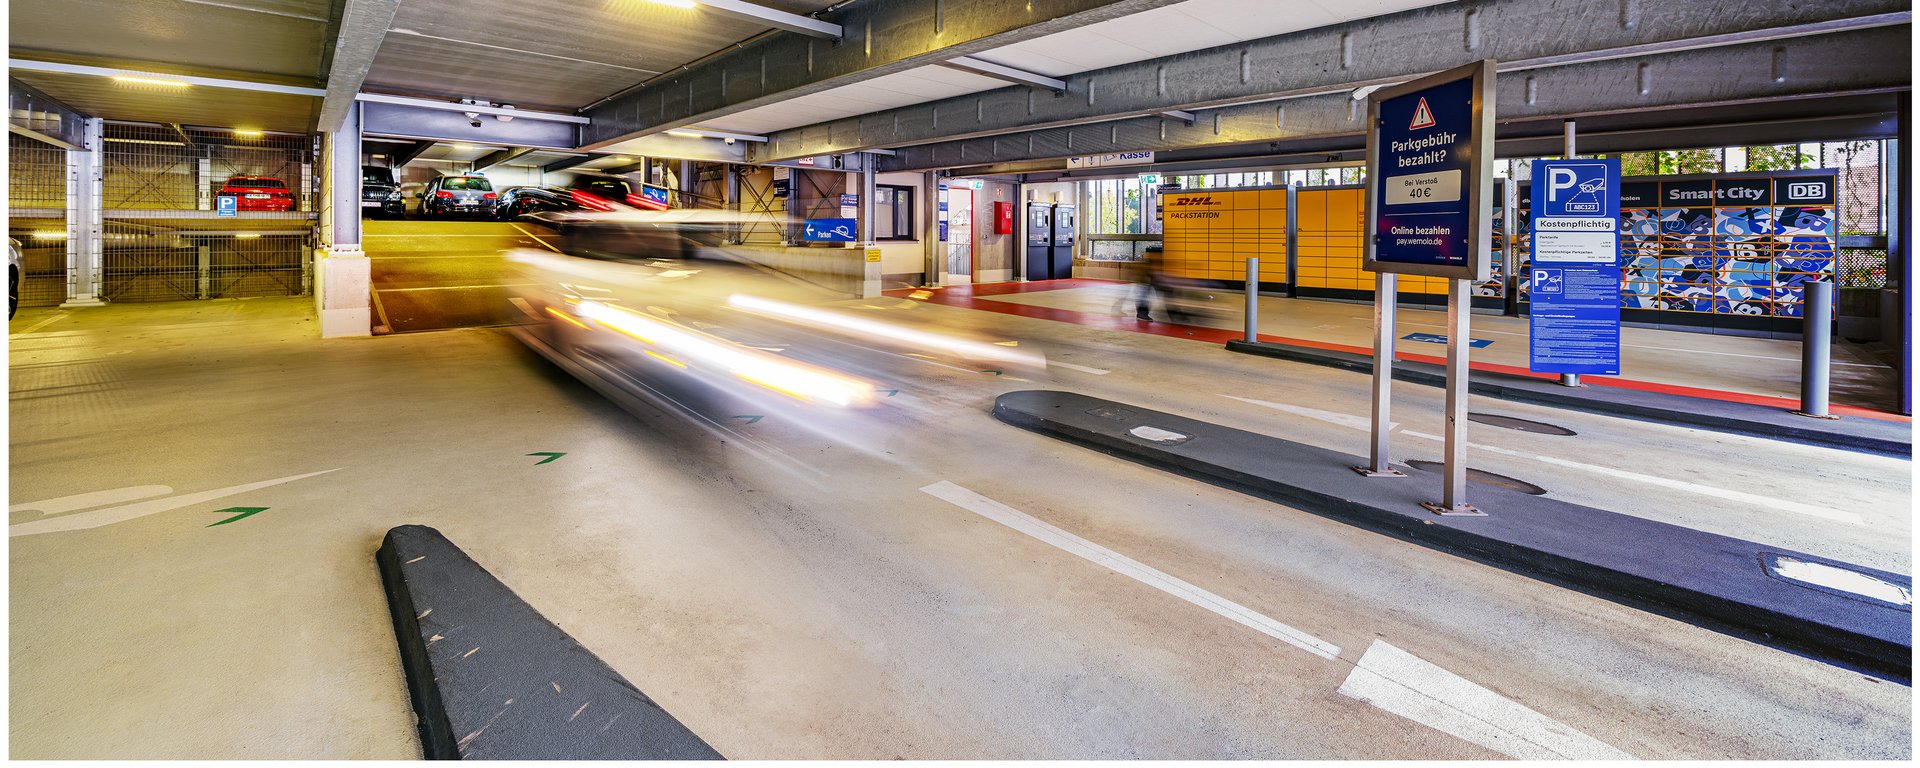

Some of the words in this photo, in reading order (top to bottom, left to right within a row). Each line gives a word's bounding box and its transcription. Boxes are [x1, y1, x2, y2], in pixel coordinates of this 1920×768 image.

[1391, 132, 1457, 153] Parkgebühr
[1398, 149, 1447, 168] bezahlt?
[1404, 179, 1414, 187] Bei
[1415, 177, 1438, 186] Verstoß
[1548, 168, 1577, 202] P
[1669, 187, 1725, 200] Smart
[1727, 186, 1765, 201] City
[1792, 185, 1822, 198] DB
[221, 197, 233, 209] P
[1176, 196, 1214, 206] DHL
[1170, 211, 1220, 219] PACKSTATION
[1540, 219, 1611, 230] Kostenpflichtig
[817, 231, 832, 239] Parken
[1391, 227, 1414, 236] Online
[1415, 226, 1450, 235] bezahlen
[1396, 237, 1443, 246] pay.wemolo.de
[1534, 270, 1549, 287] P
